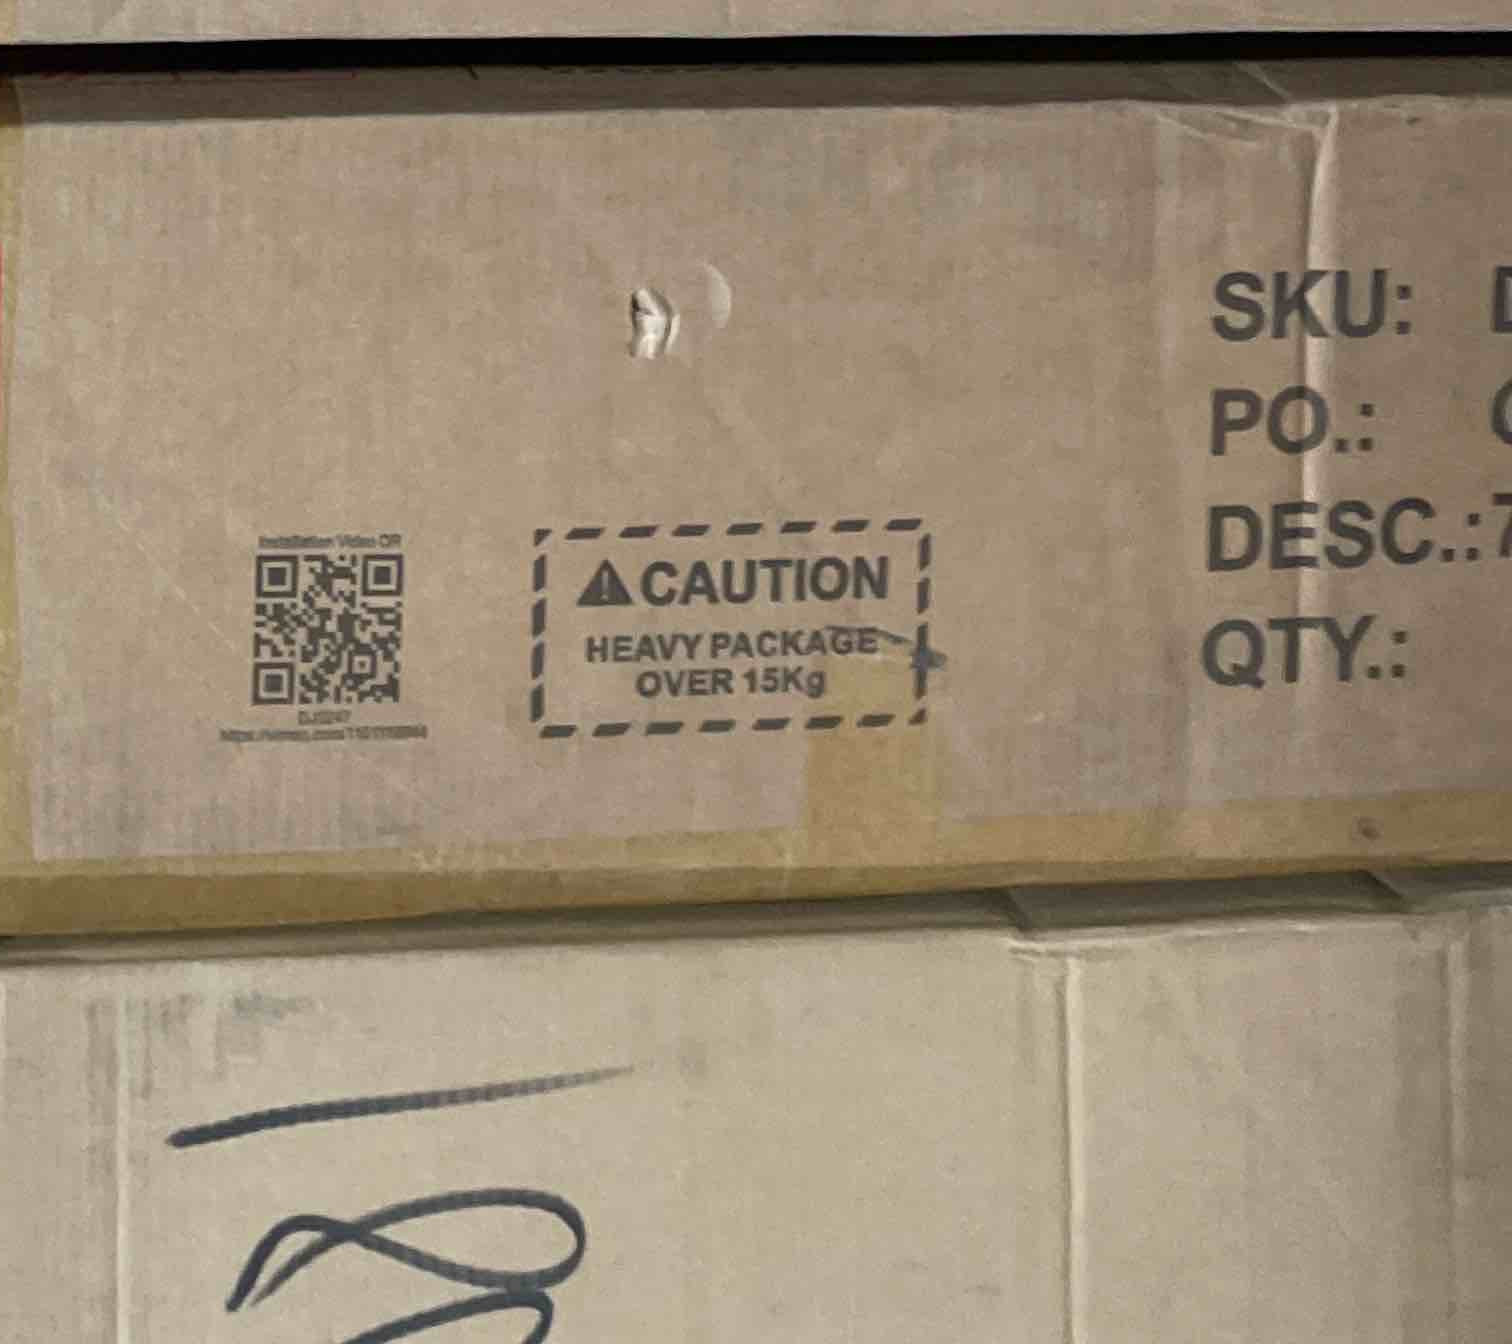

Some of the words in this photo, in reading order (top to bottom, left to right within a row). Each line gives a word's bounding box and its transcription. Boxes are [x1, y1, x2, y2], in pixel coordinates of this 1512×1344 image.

[1211, 269, 1413, 343] SKU:
[1209, 384, 1375, 457] PO.:
[639, 556, 889, 607] CAUTION
[585, 633, 702, 663] HEAVY
[710, 628, 879, 661] PACKAGE
[1201, 614, 1407, 689] QTY.:
[635, 669, 734, 699] OVER
[742, 666, 827, 700] 15Kg
